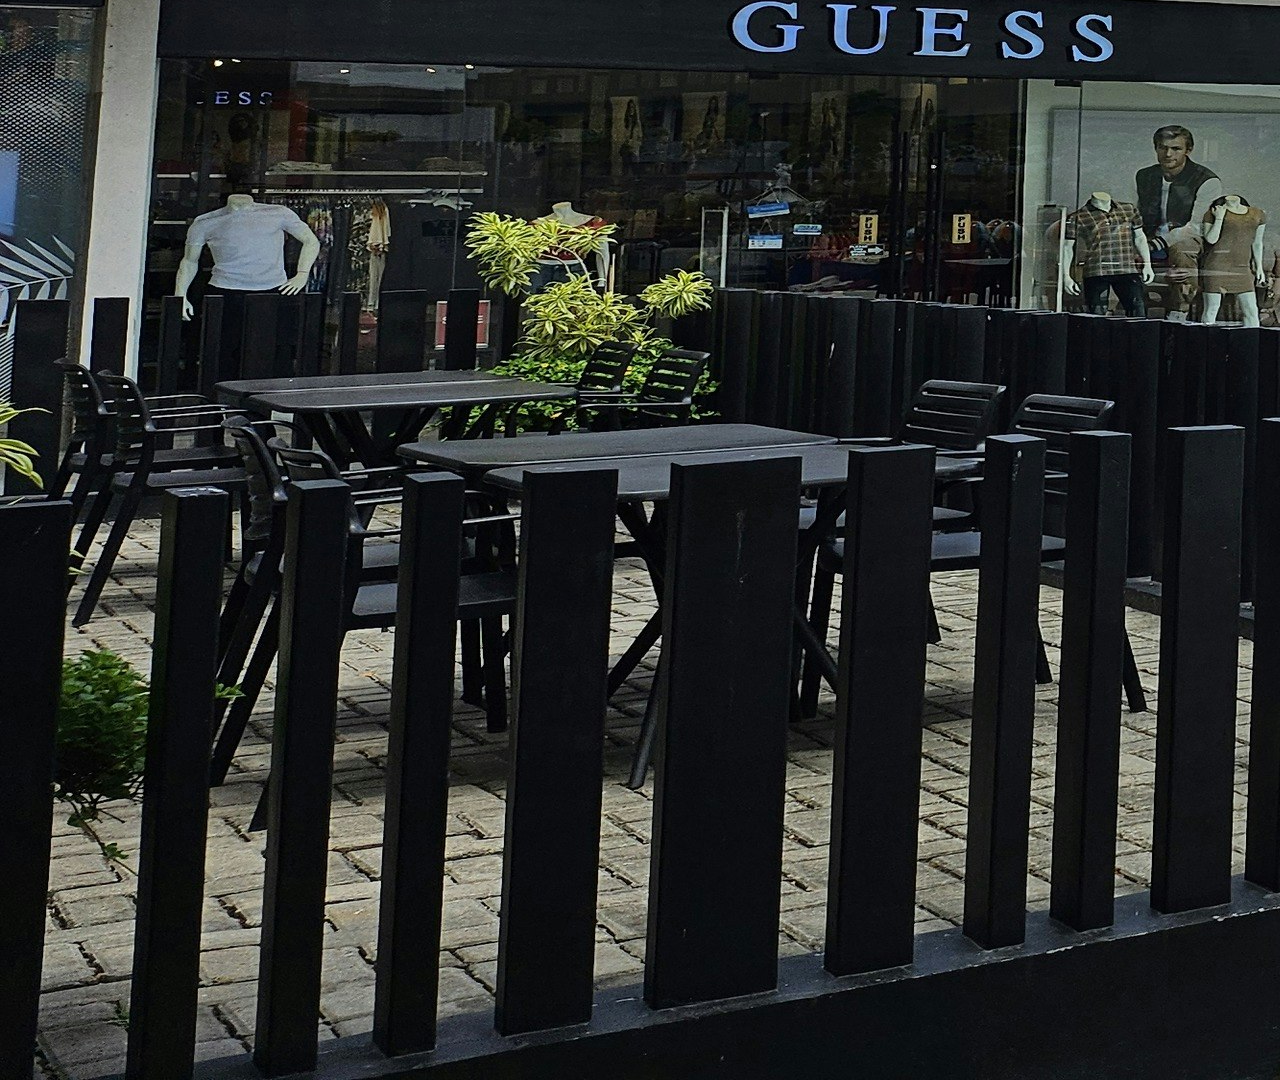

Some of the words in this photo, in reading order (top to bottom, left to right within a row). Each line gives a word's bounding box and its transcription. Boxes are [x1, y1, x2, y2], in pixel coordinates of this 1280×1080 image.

[732, 1, 1114, 62] GUESS
[864, 217, 873, 241] PUSH
[957, 216, 966, 240] PUSH
